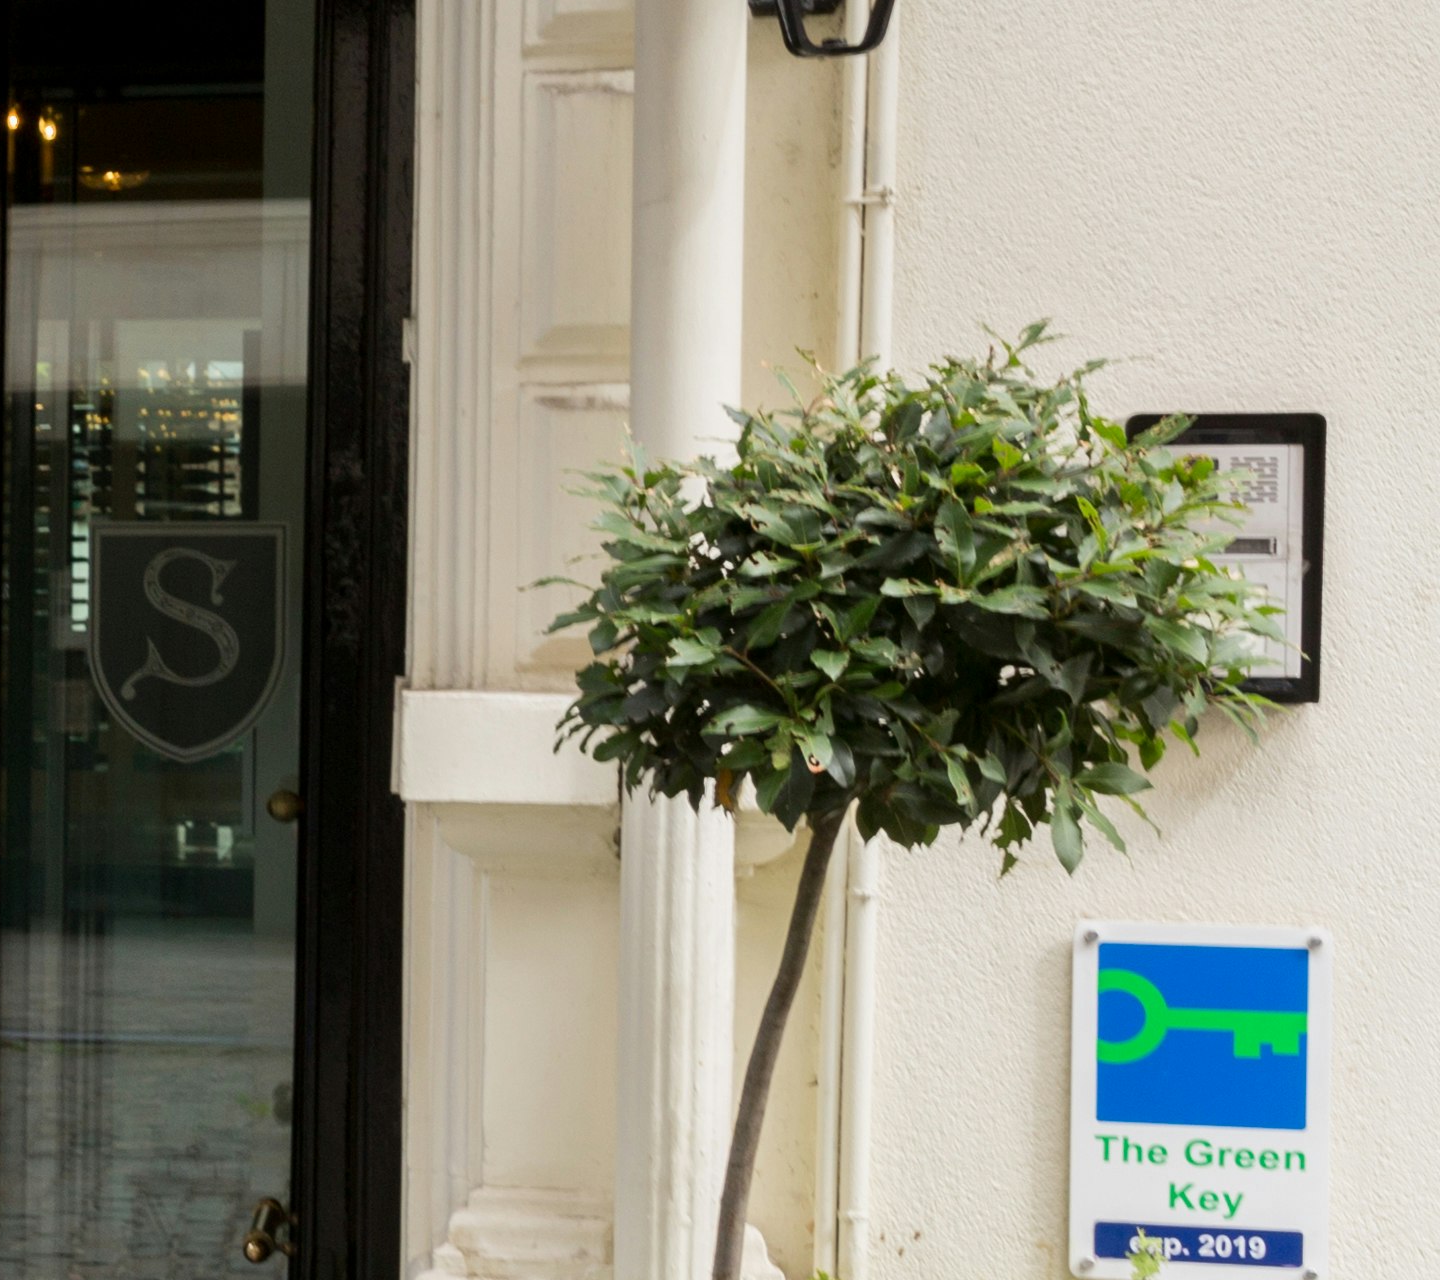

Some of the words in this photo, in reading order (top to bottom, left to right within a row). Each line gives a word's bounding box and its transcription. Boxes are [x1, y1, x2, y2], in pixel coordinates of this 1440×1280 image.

[1095, 1134, 1169, 1166] The
[1183, 1138, 1307, 1172] Green
[1168, 1182, 1244, 1220] Key
[1198, 1233, 1267, 1260] 2019
